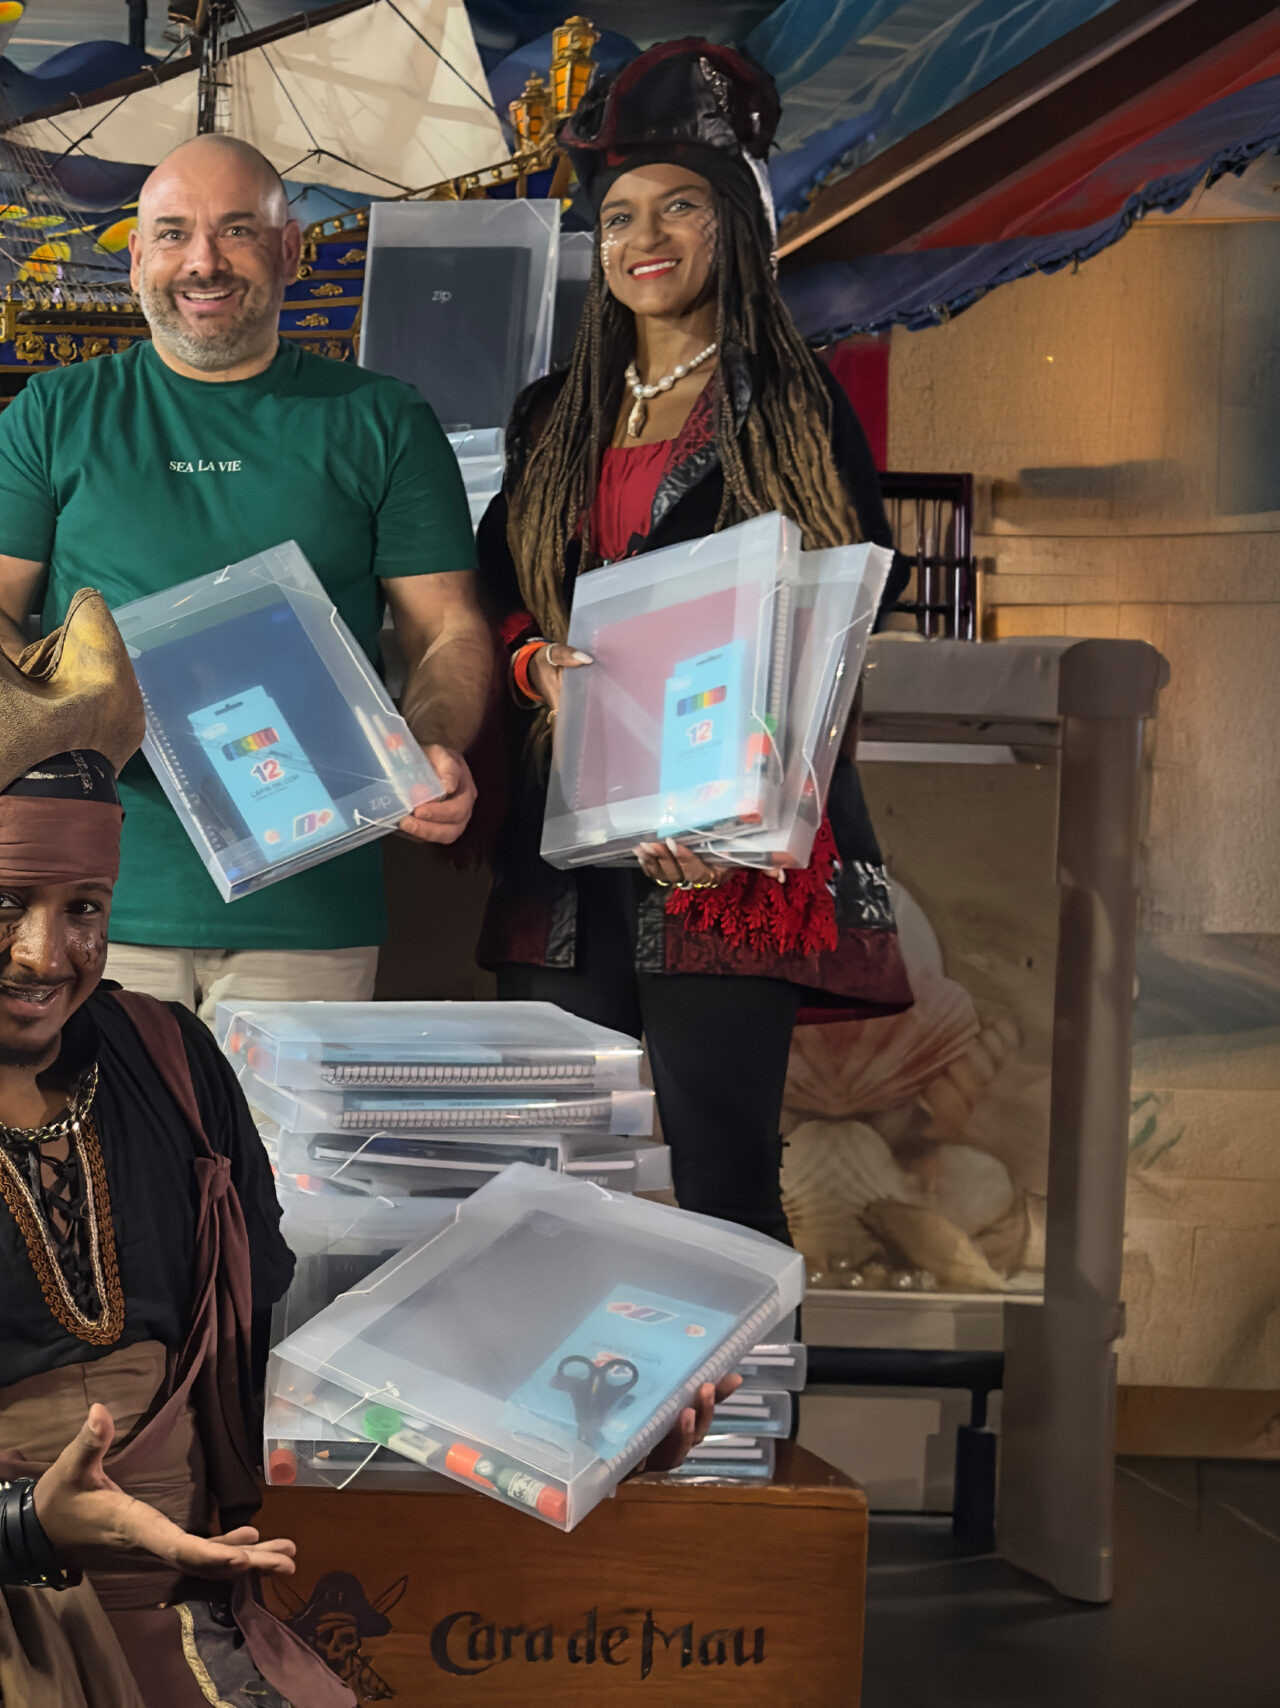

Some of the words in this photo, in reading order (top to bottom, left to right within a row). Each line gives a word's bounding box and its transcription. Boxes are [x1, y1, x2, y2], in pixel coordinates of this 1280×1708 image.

[169, 460, 194, 473] SEA
[198, 460, 216, 472] LA
[218, 460, 242, 472] VIE
[685, 719, 713, 746] 12
[251, 758, 285, 784] 12
[430, 1611, 554, 1676] Cara
[567, 1606, 630, 1666] de
[640, 1610, 767, 1680] Mau
